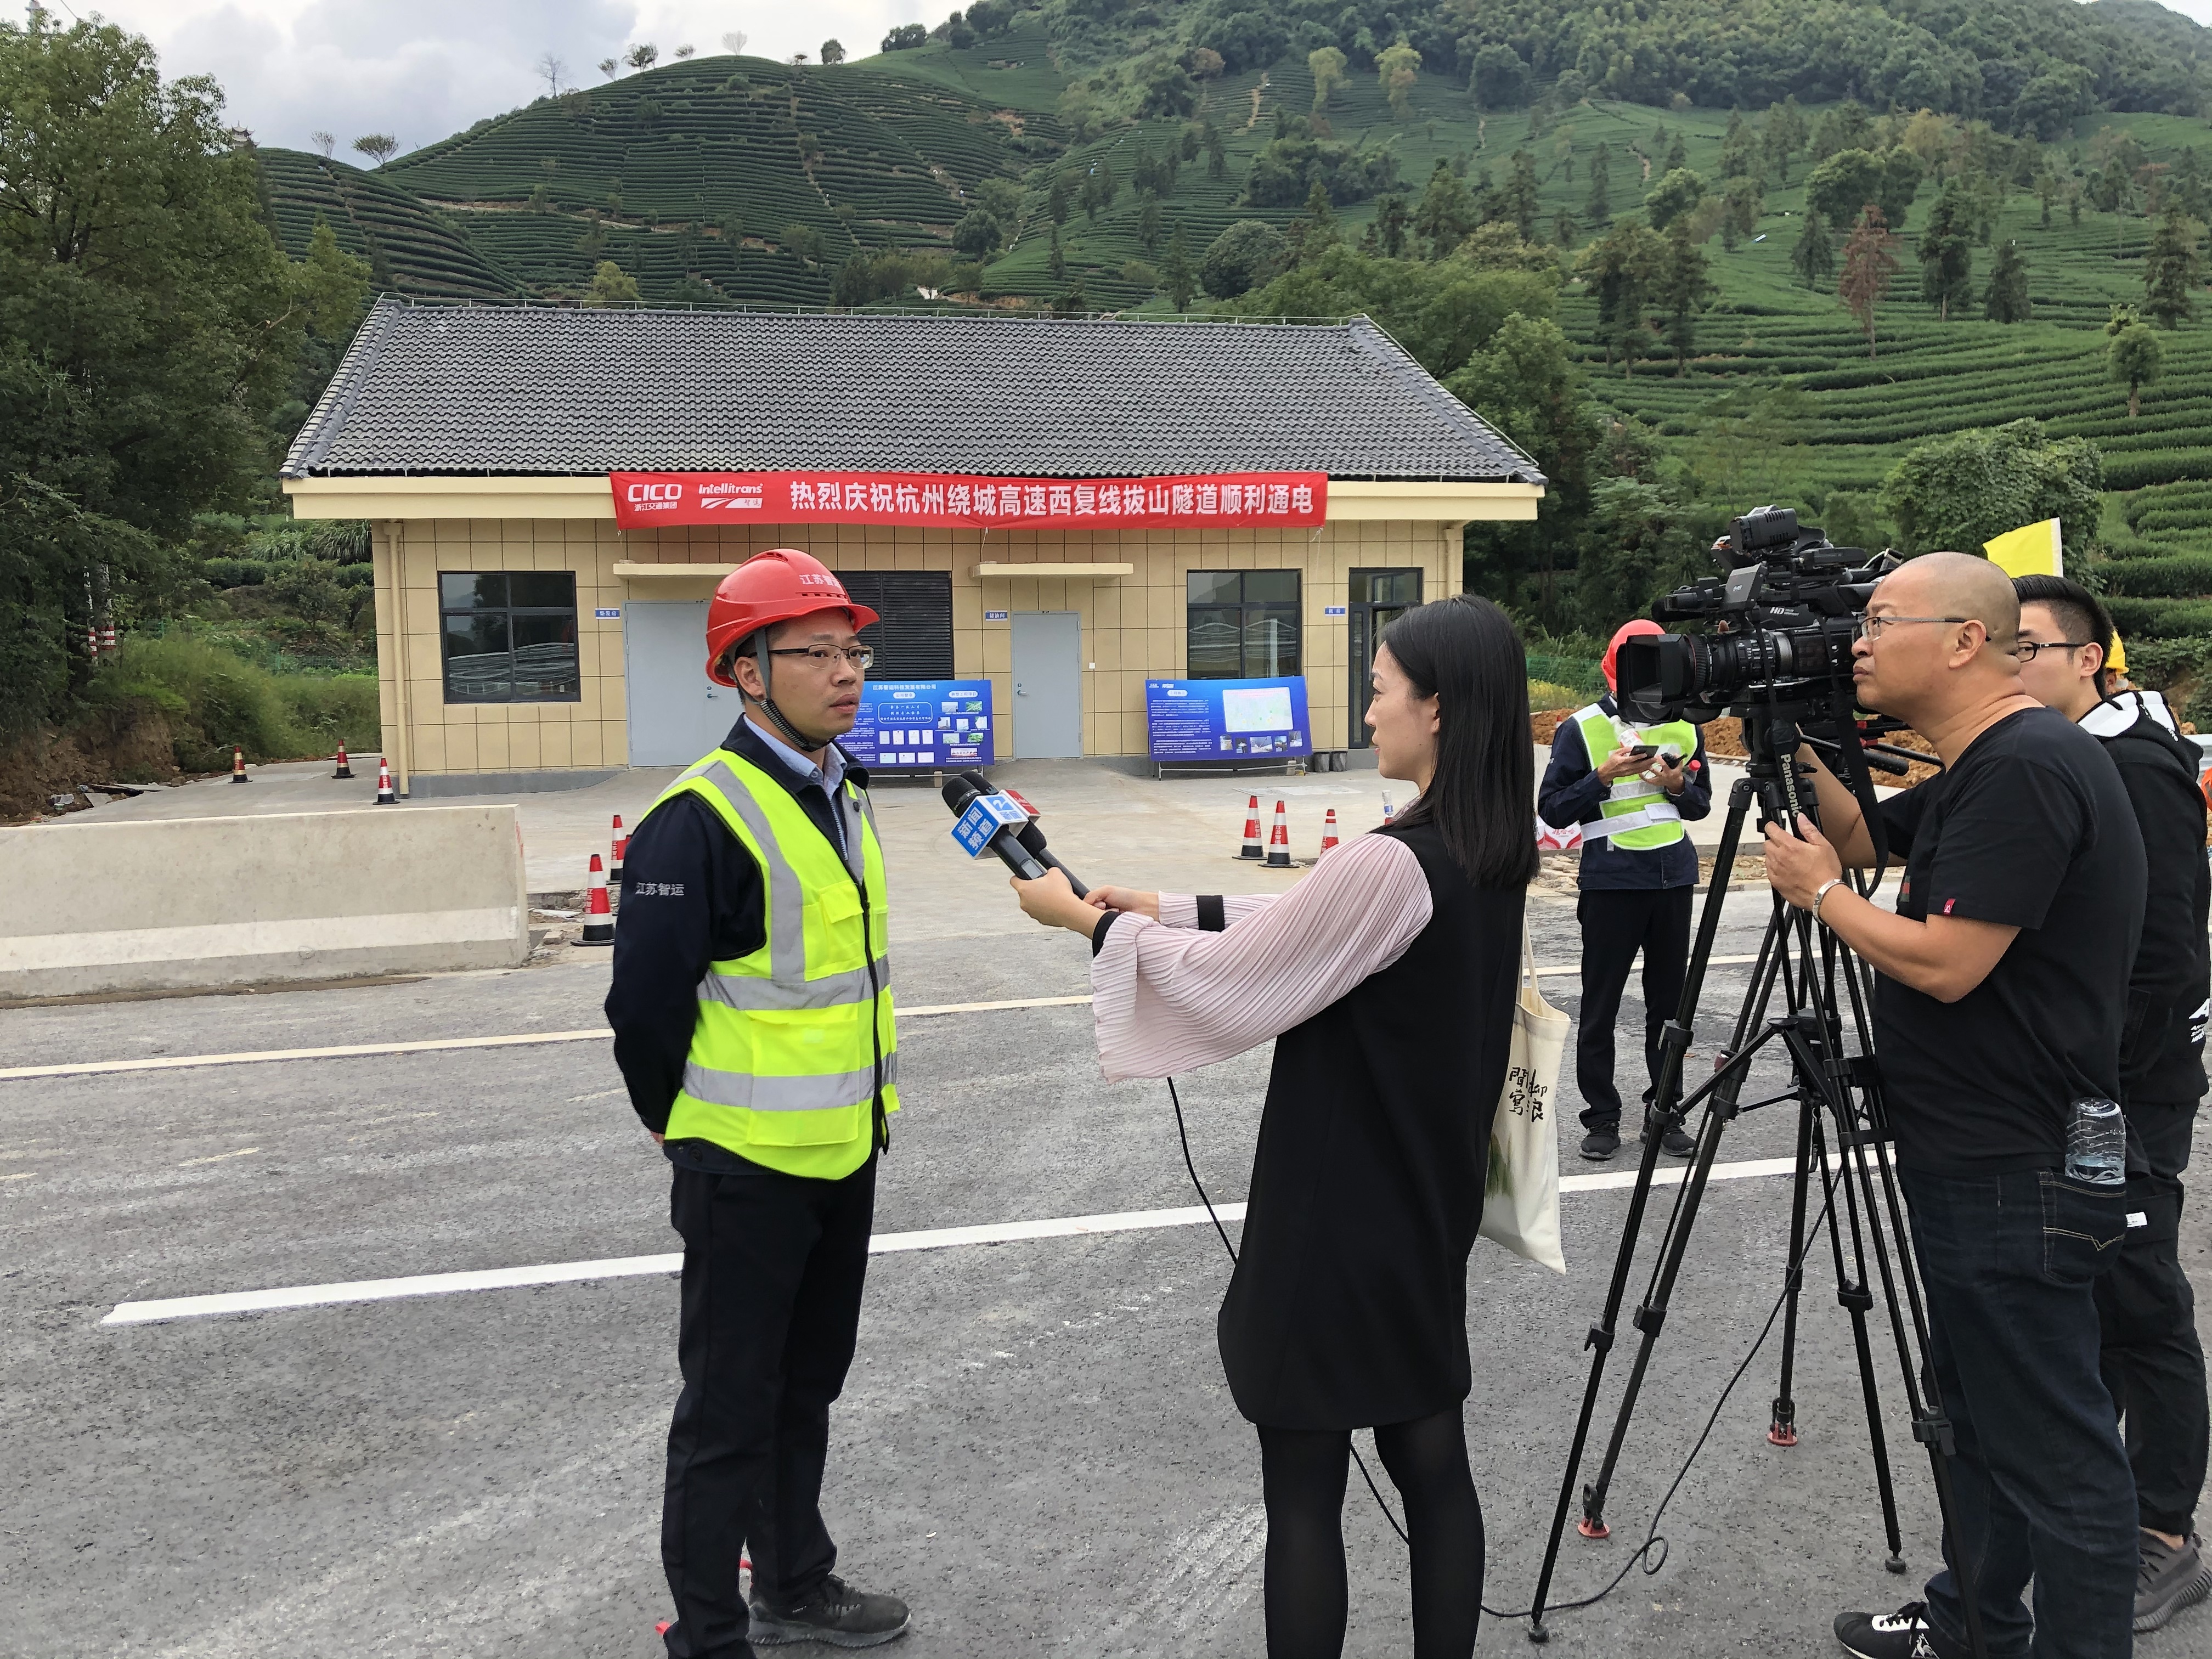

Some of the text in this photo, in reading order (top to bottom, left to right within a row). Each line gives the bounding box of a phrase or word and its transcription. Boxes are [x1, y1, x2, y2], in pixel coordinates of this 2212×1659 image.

[628, 483, 682, 502] CICO
[698, 483, 763, 494] Intellitrans
[791, 481, 1313, 516] 热烈庆祝杭州绕城高速西复线拔山隧道顺利通电
[634, 501, 678, 512] 浙江交通集团
[1781, 754, 1802, 817] Panasonic
[957, 806, 983, 838] 新闻
[967, 818, 994, 850] 频道
[635, 882, 685, 896] 江苏智运
